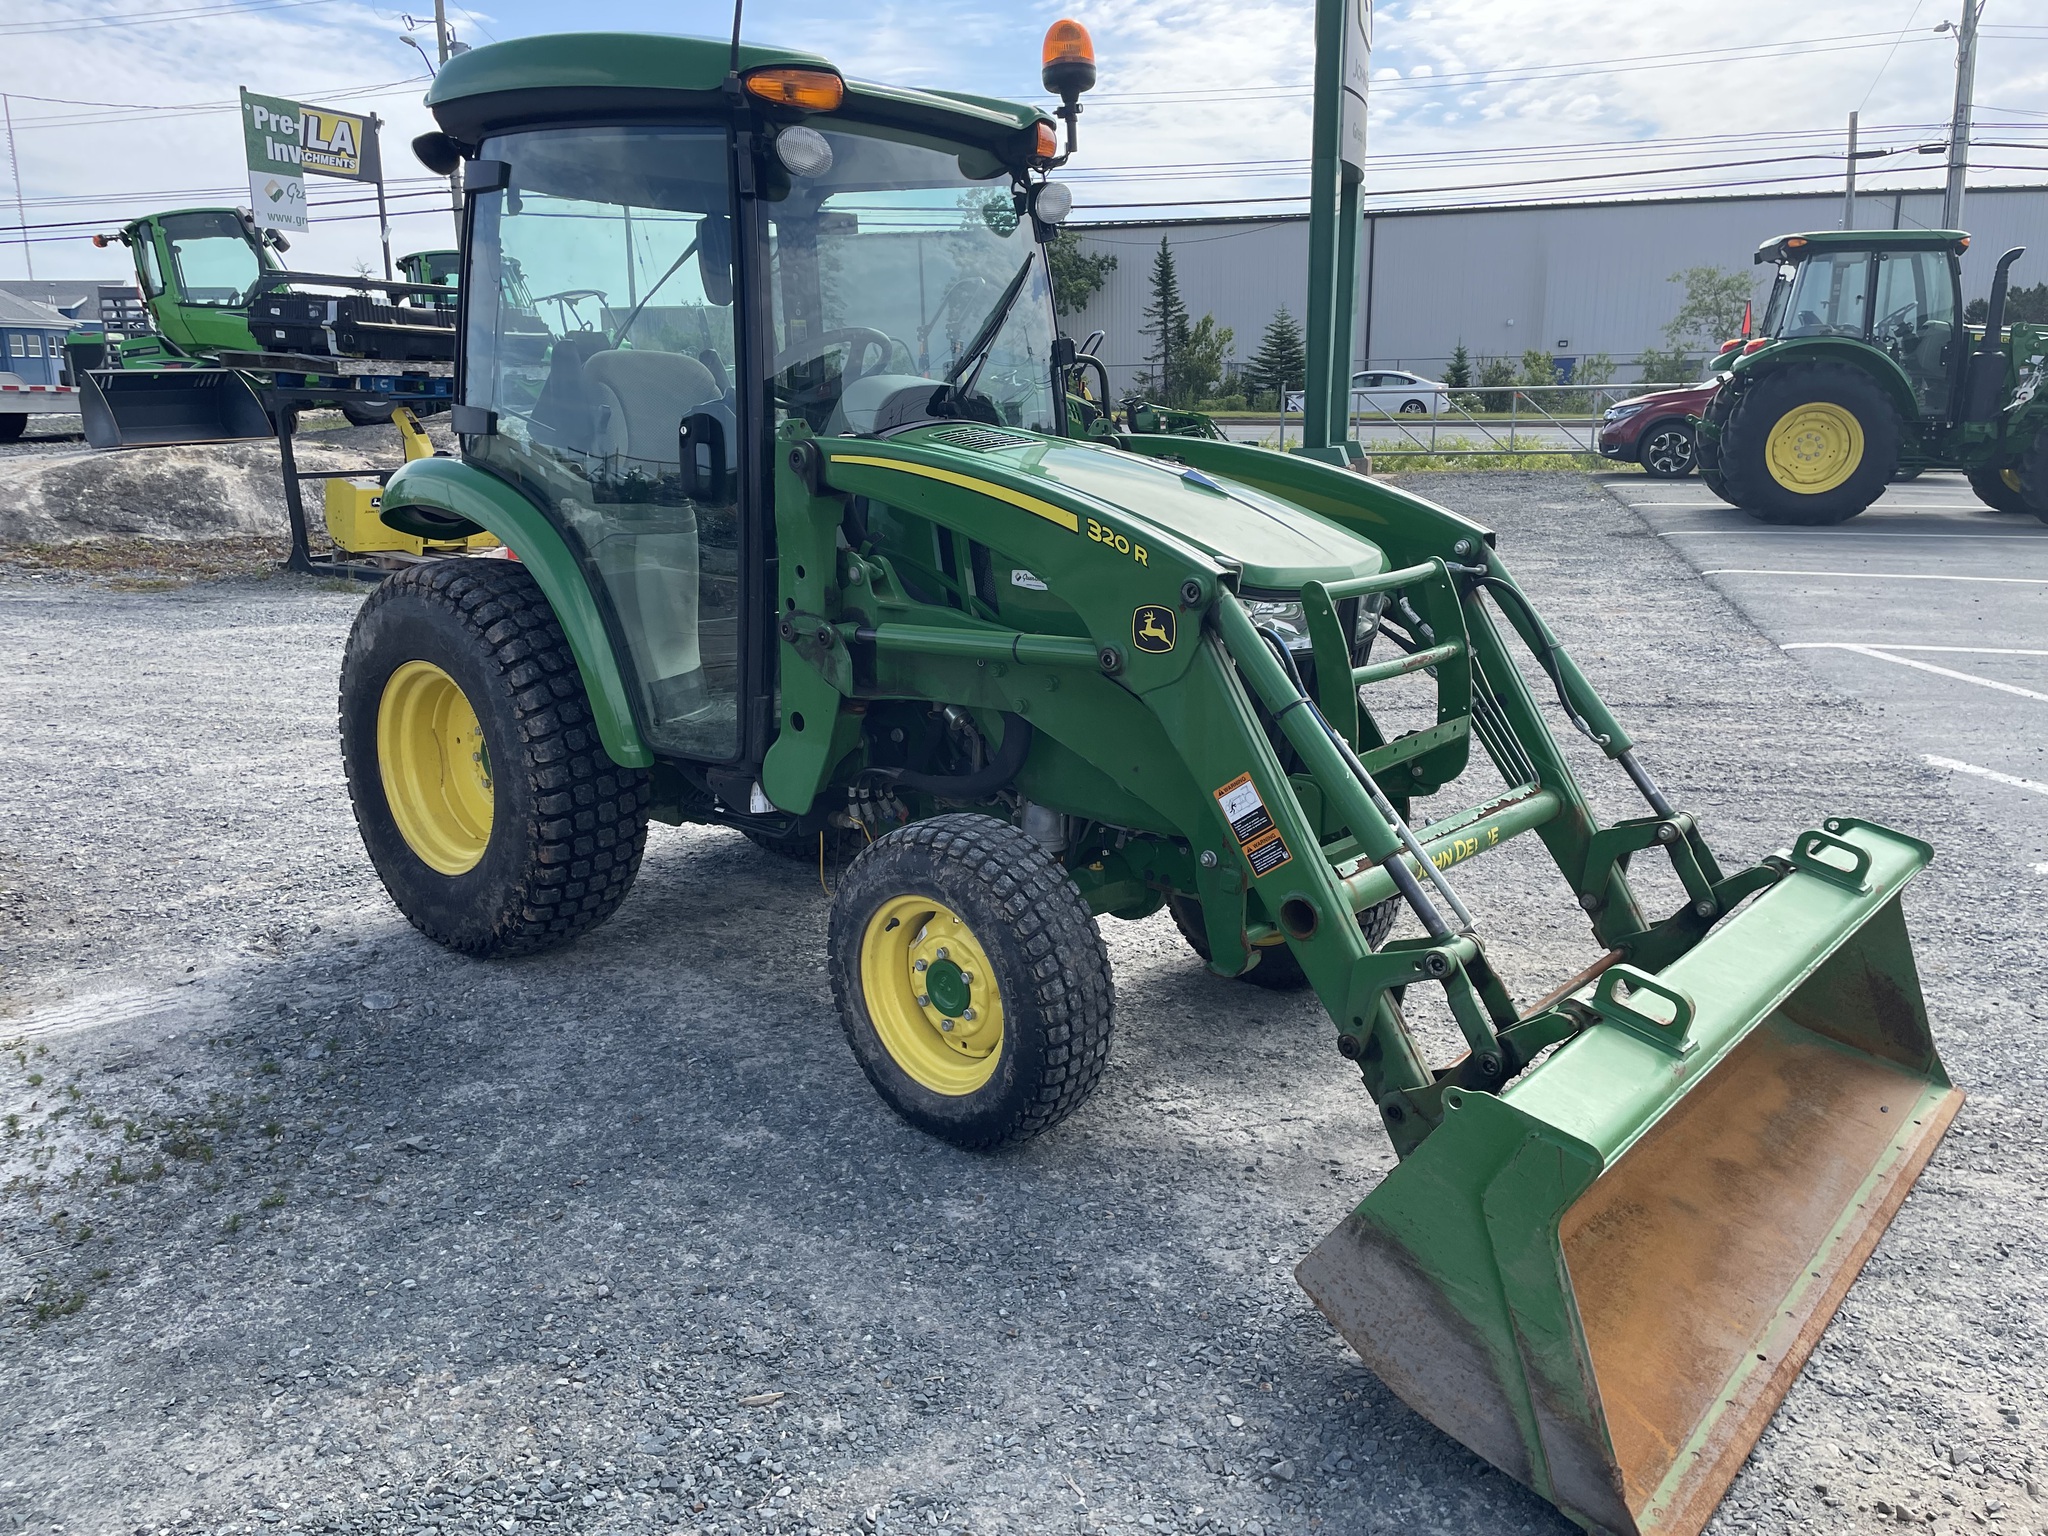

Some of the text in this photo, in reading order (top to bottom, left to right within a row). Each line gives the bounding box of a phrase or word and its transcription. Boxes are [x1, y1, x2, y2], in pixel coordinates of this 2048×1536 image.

[267, 212, 308, 227] www.gr
[1086, 517, 1150, 568] 320 R
[1223, 776, 1247, 793] WARNING
[1252, 833, 1277, 849] WARNING
[1416, 848, 1453, 880] JHN
